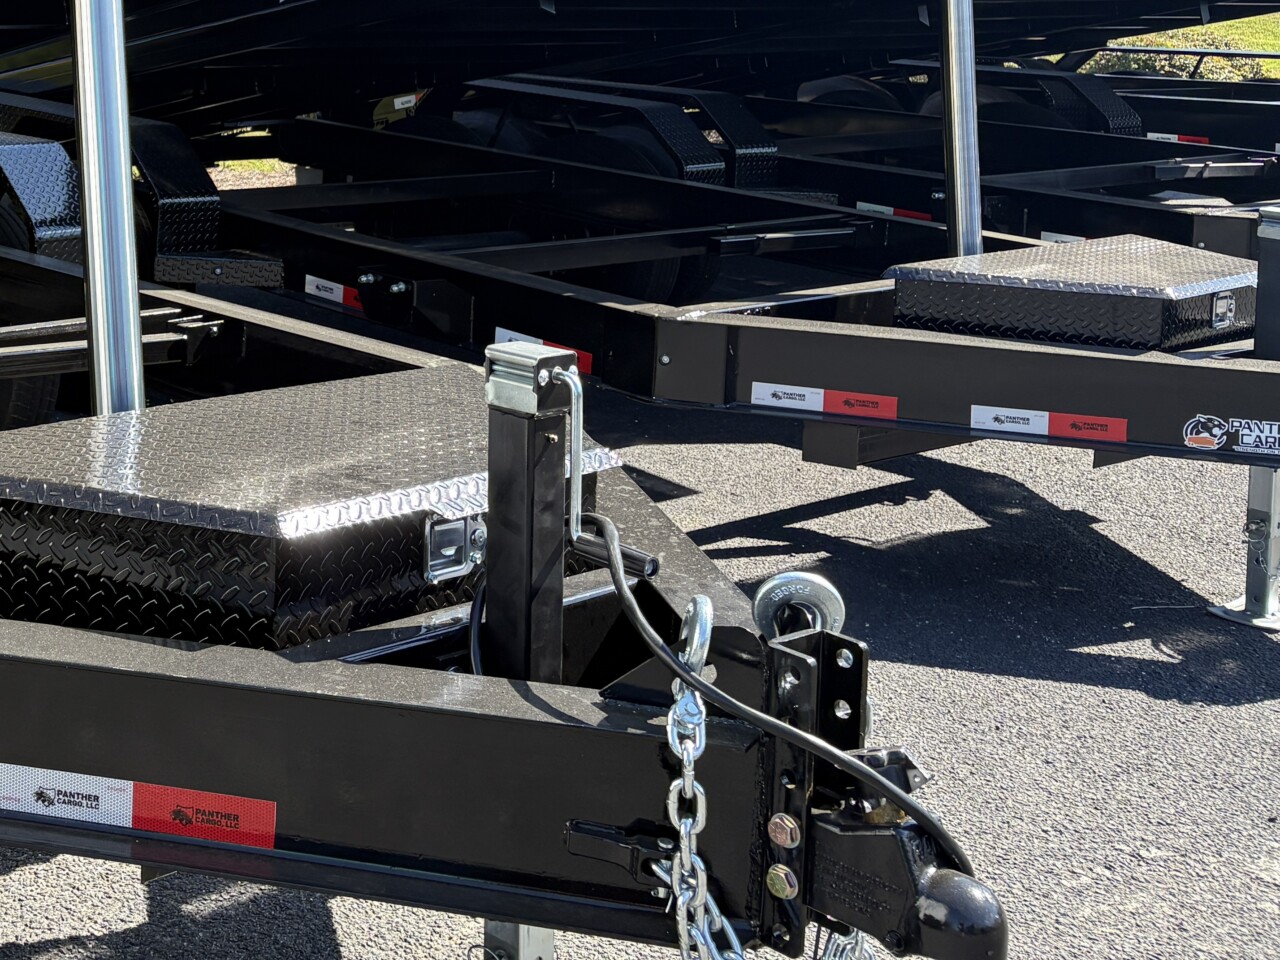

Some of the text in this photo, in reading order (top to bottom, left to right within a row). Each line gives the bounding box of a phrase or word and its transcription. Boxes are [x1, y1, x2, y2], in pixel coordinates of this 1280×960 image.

[770, 584, 811, 601] FORGED
[57, 789, 100, 802] PANTHER
[56, 797, 100, 809] CARGO, LLC
[195, 808, 240, 822] PANTHER
[195, 816, 240, 829] CARGO, LLC
